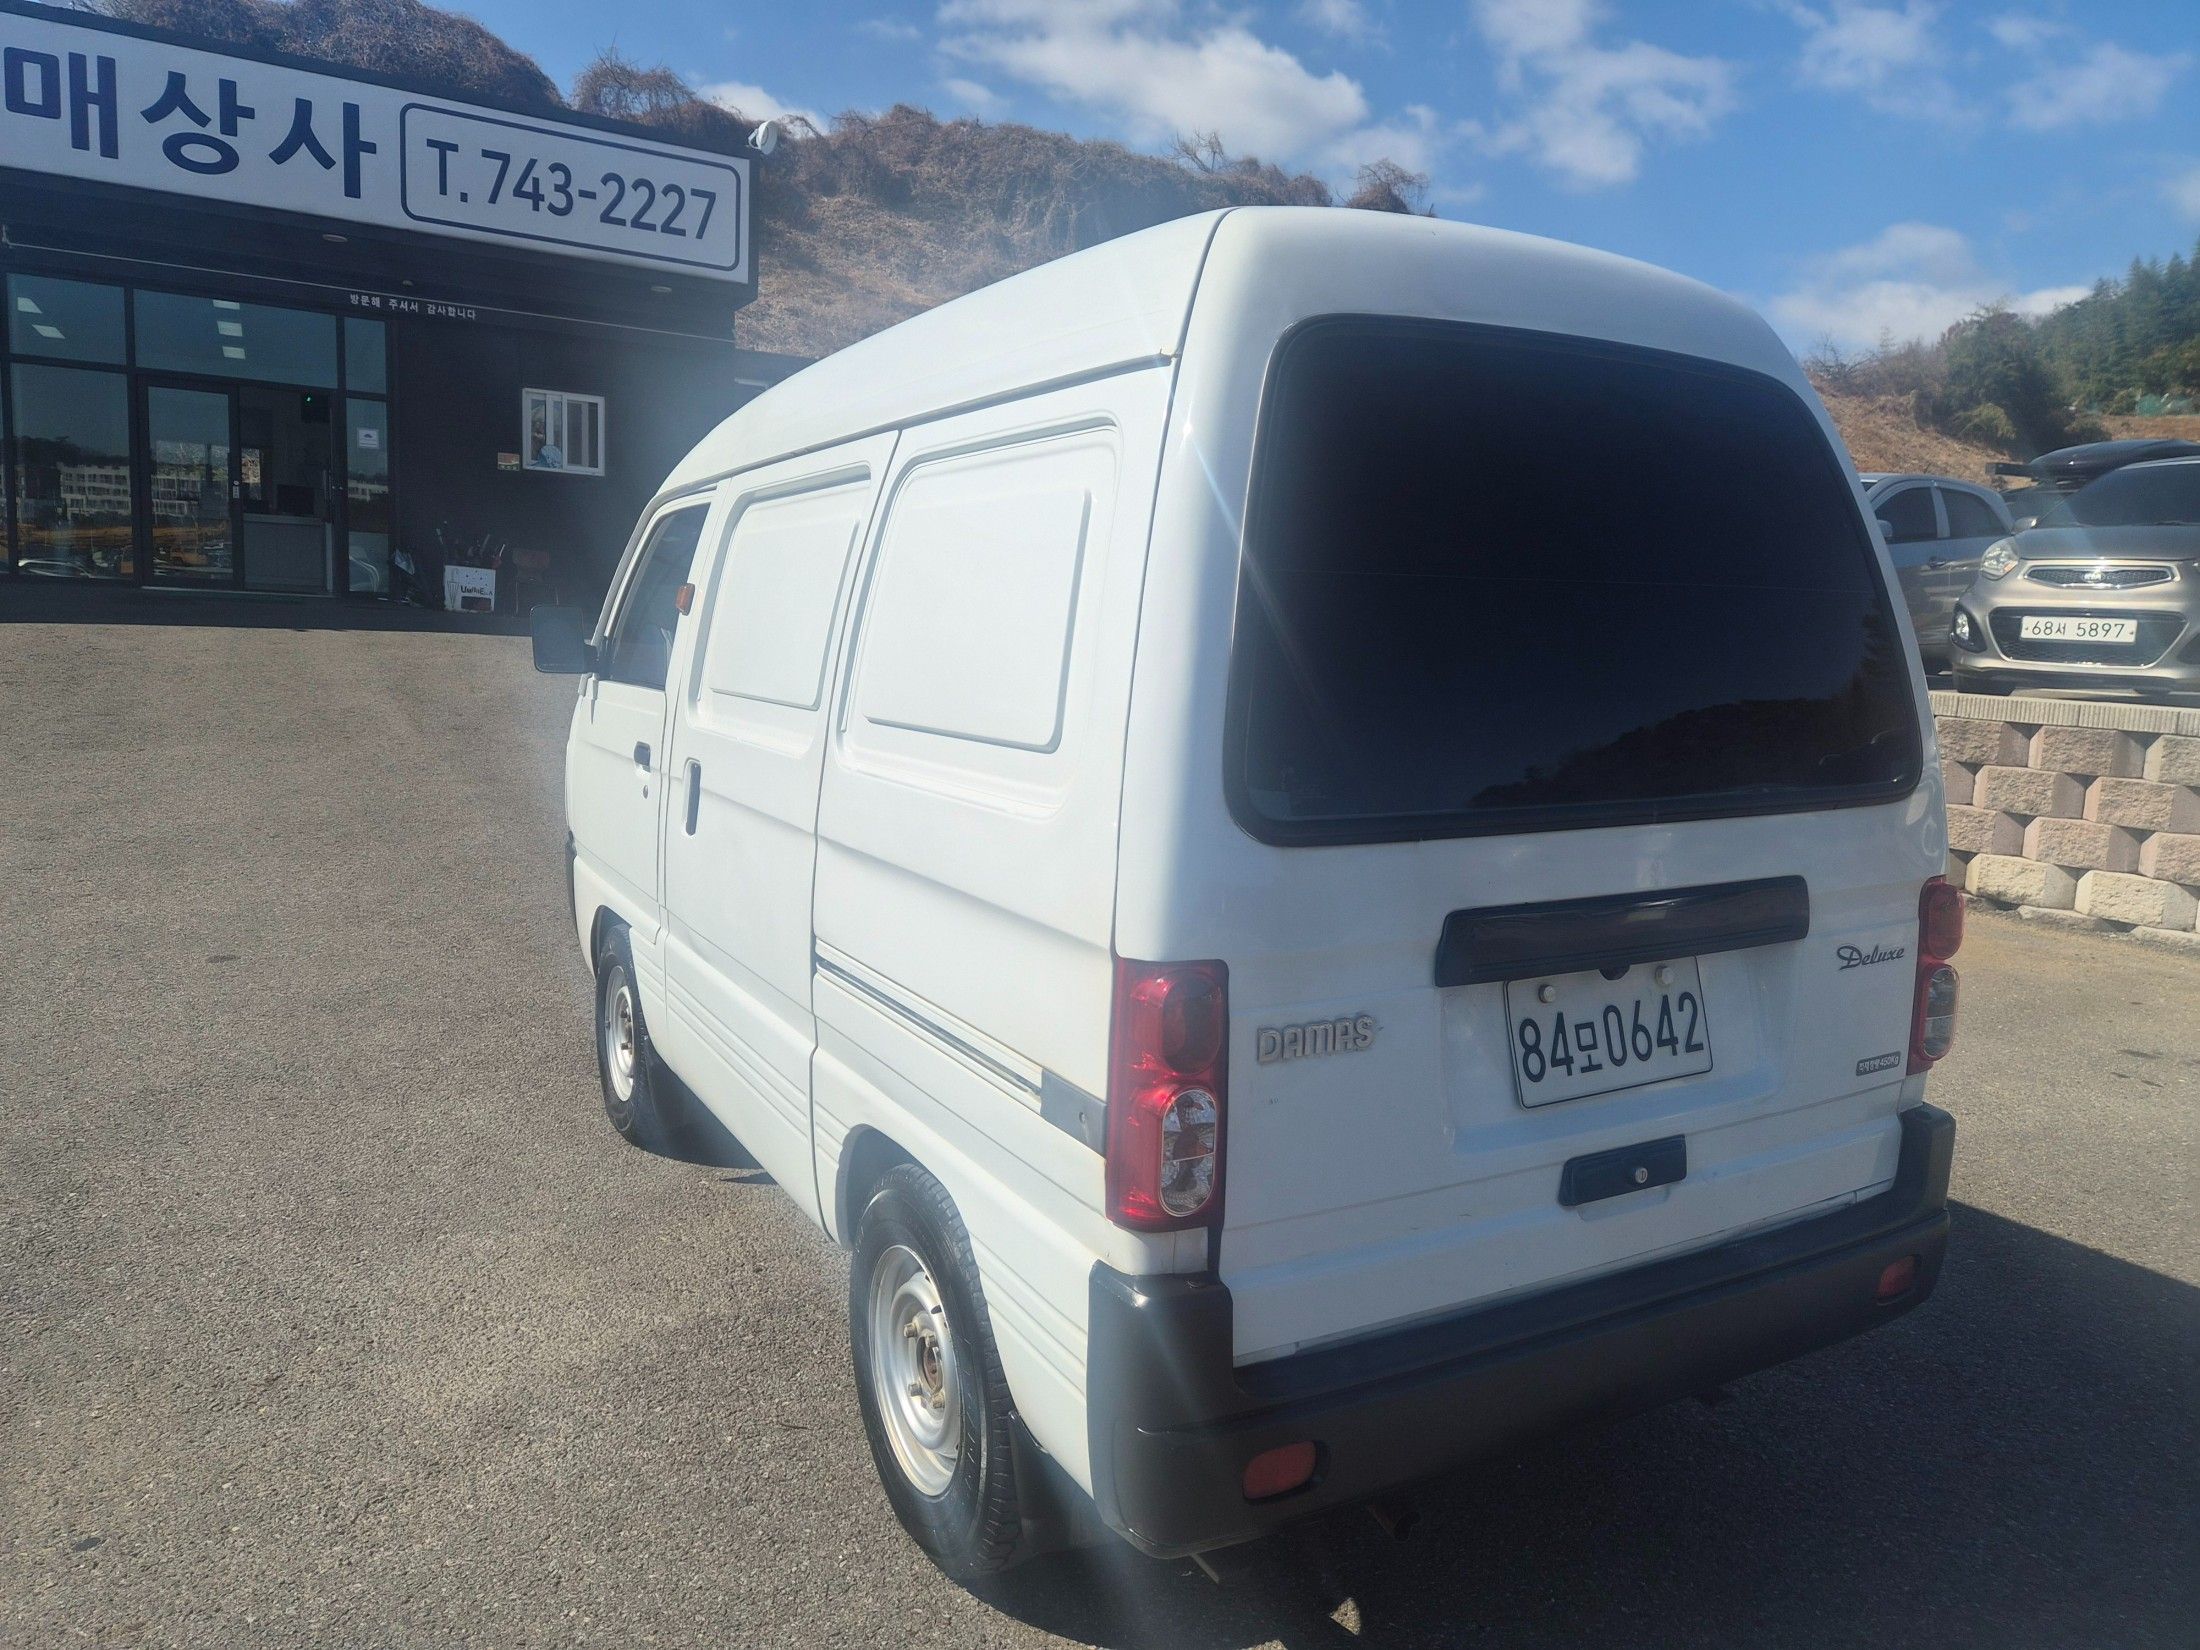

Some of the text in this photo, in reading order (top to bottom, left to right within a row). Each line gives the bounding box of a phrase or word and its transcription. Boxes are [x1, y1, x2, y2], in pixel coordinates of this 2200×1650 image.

[3, 46, 378, 199] 매상사
[425, 138, 718, 240] T.743-2227
[350, 293, 477, 320] 방문해 주셔서 감사합니다
[2031, 620, 2126, 638] 68서 5897
[1837, 945, 1905, 971] Deluxe
[1257, 1014, 1377, 1064] DAMAS
[1518, 991, 1704, 1083] 84모0642
